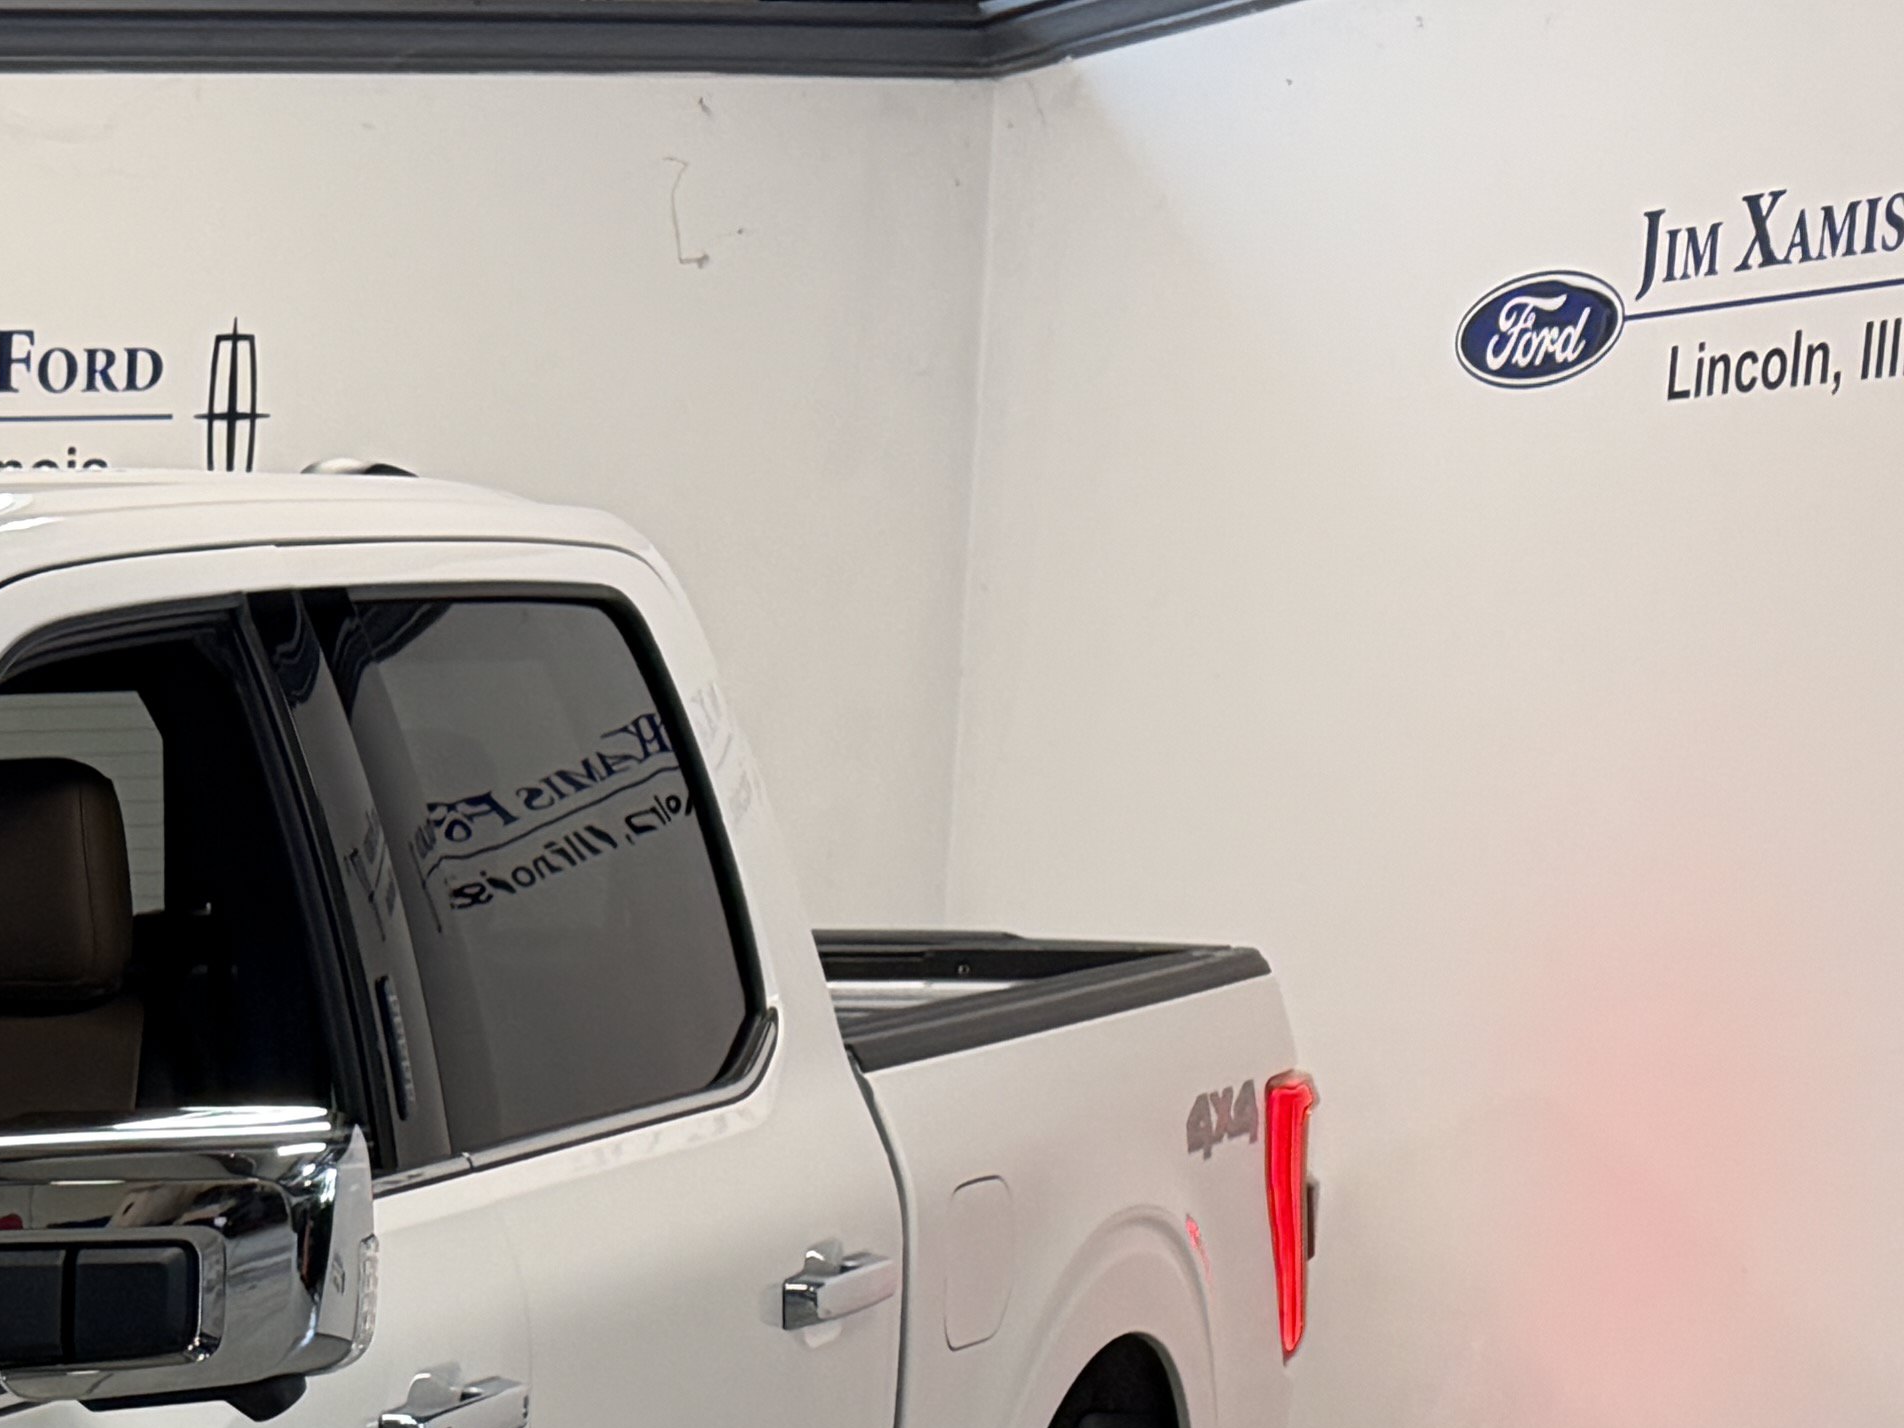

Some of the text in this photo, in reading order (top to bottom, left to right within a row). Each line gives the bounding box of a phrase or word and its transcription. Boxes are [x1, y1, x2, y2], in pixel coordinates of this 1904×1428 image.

[1635, 189, 1904, 302] JIM XAMIS
[1485, 292, 1591, 371] Ford
[1666, 329, 1842, 402] Lincoln,
